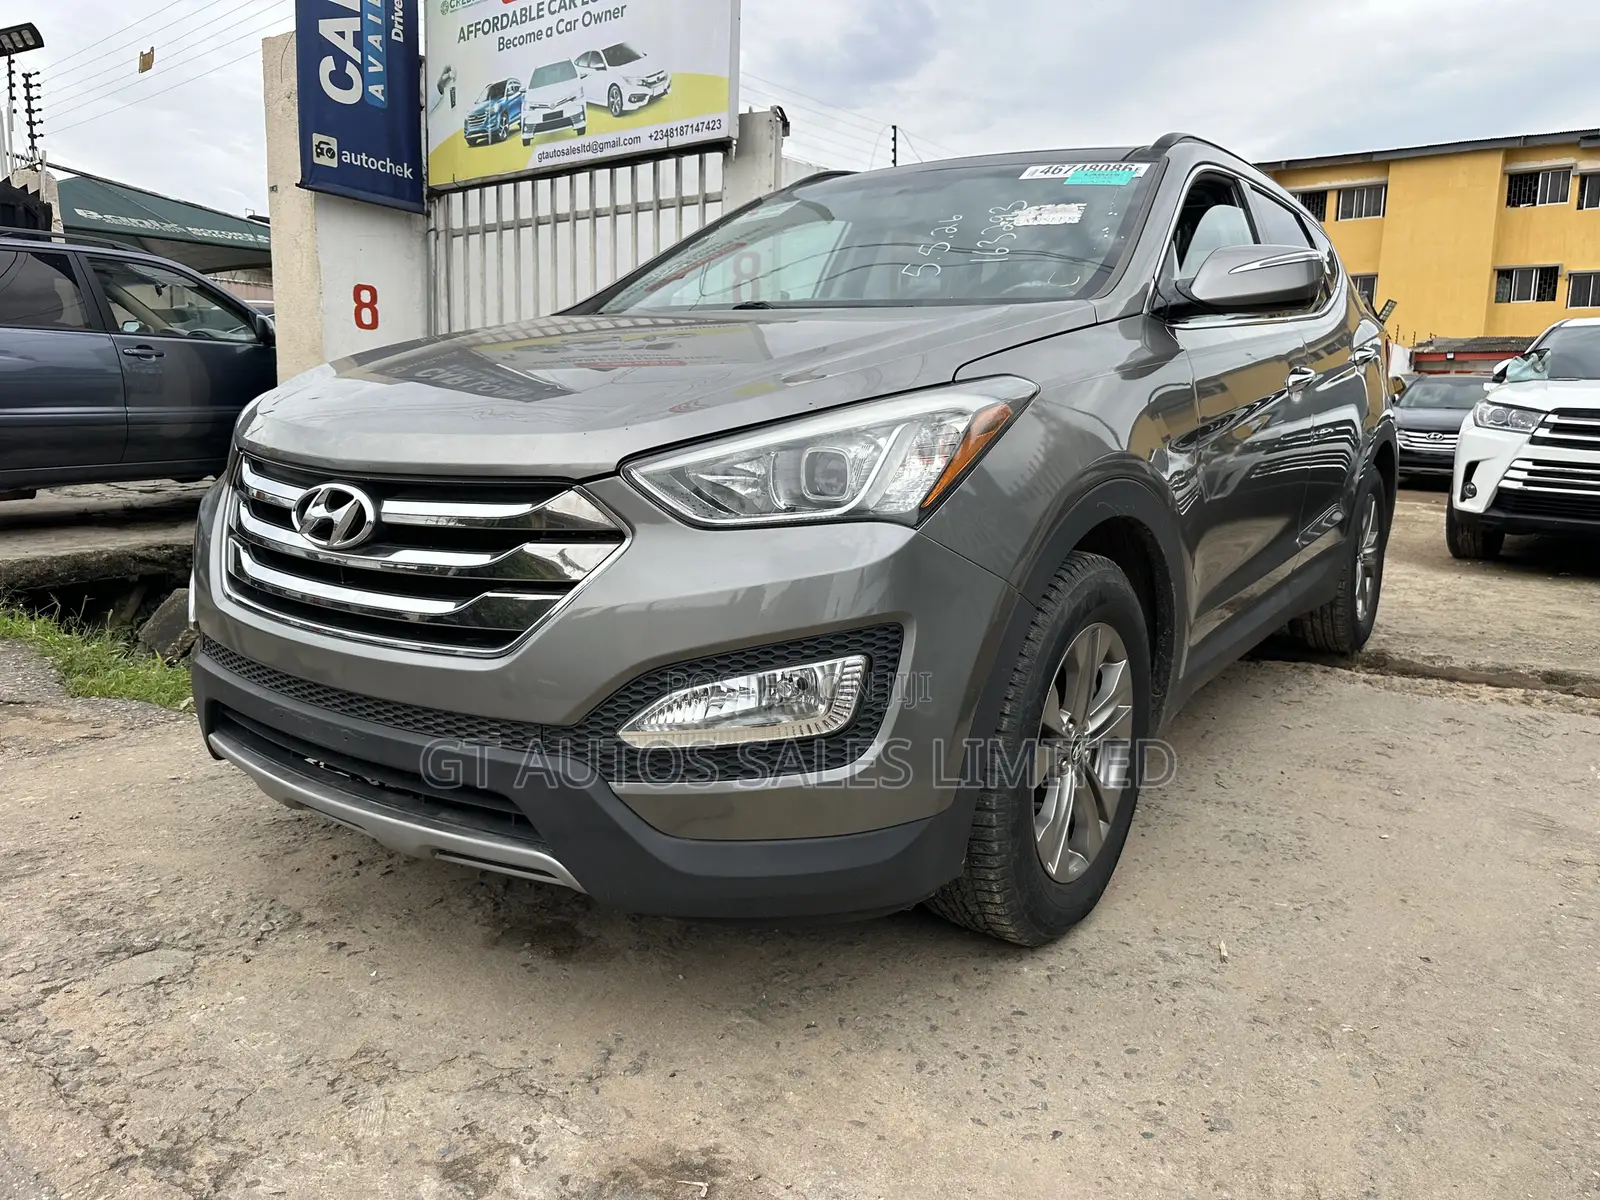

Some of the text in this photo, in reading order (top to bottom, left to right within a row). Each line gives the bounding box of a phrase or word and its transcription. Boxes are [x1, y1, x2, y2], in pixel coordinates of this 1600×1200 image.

[457, 0, 578, 44] AFFORDABLE CAR
[497, 5, 628, 52] Become a Car Owner
[318, 0, 363, 105] CA
[537, 118, 723, 163] gtautosalesltd@gmail.com +2348187147423
[341, 150, 414, 180] autochek
[352, 283, 380, 331] 8
